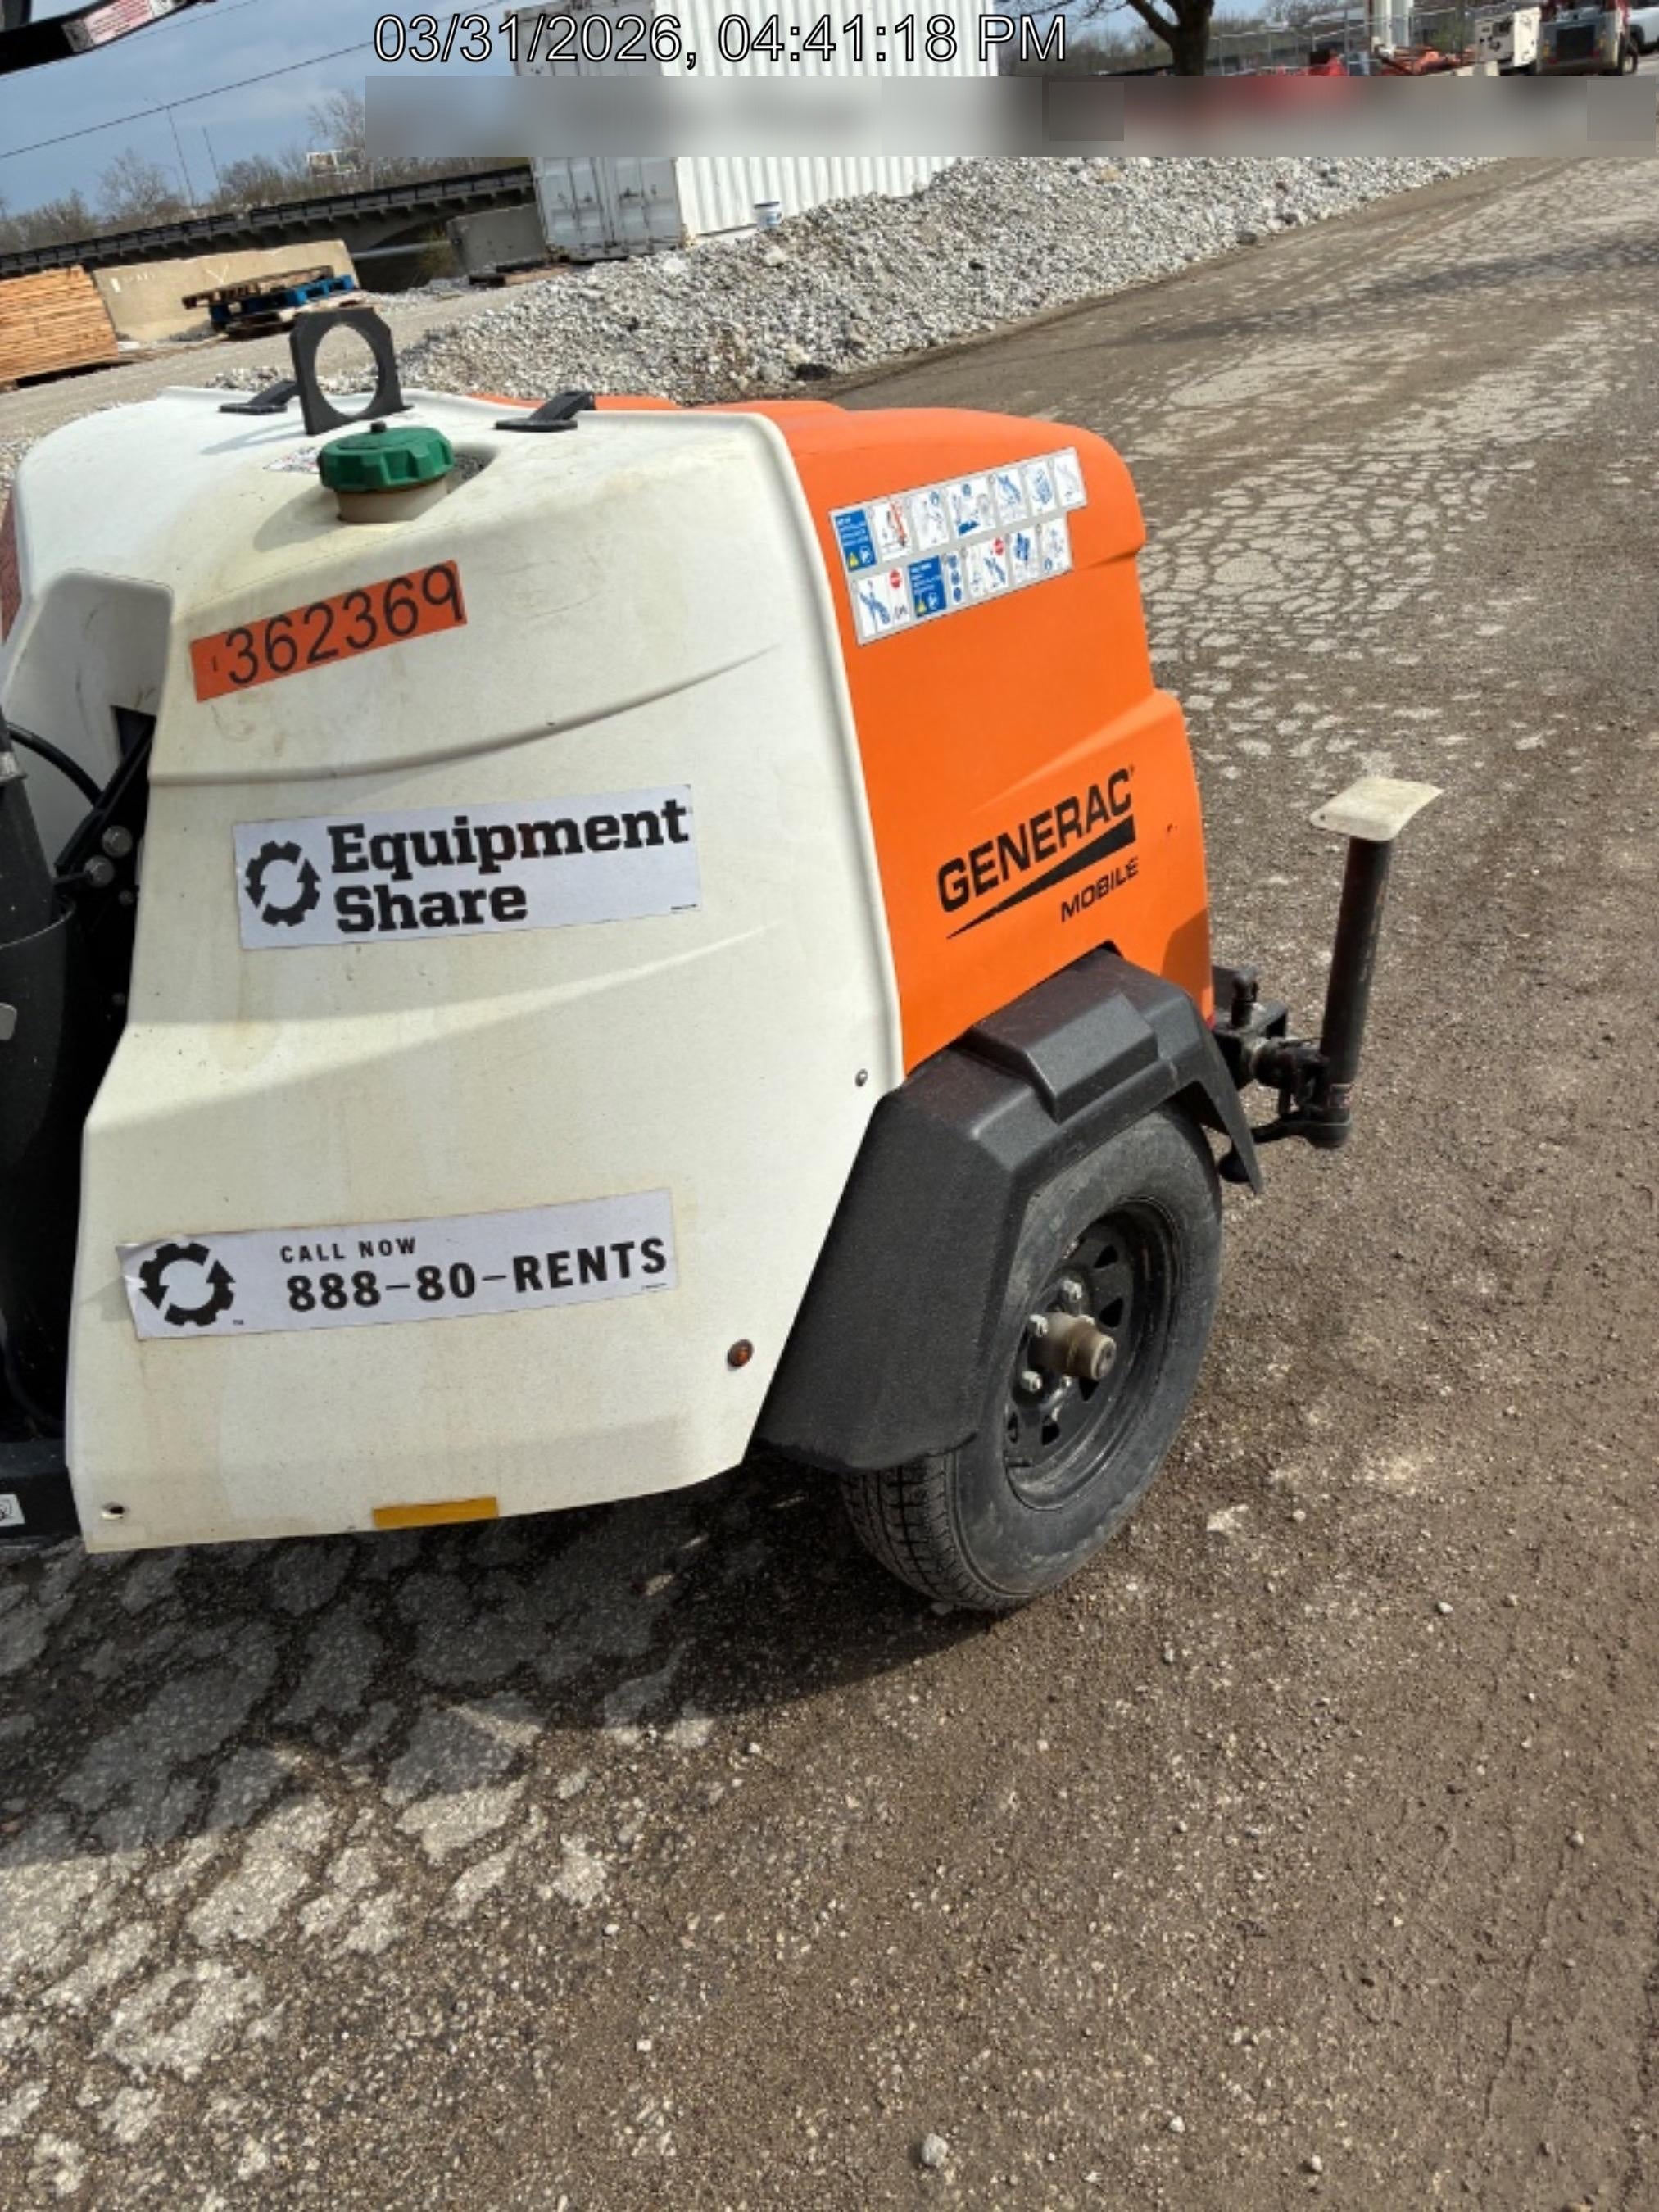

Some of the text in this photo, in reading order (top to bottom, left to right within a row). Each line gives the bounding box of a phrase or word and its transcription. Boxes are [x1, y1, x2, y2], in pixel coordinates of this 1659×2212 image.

[225, 564, 463, 685] 362369
[328, 799, 689, 881] Equipment
[937, 768, 1132, 913] GENERAC
[335, 885, 528, 933] Share
[1061, 856, 1139, 924] MOBILE
[280, 1237, 418, 1263] CALL NOW
[286, 1237, 667, 1312] 888-80-RENTS
